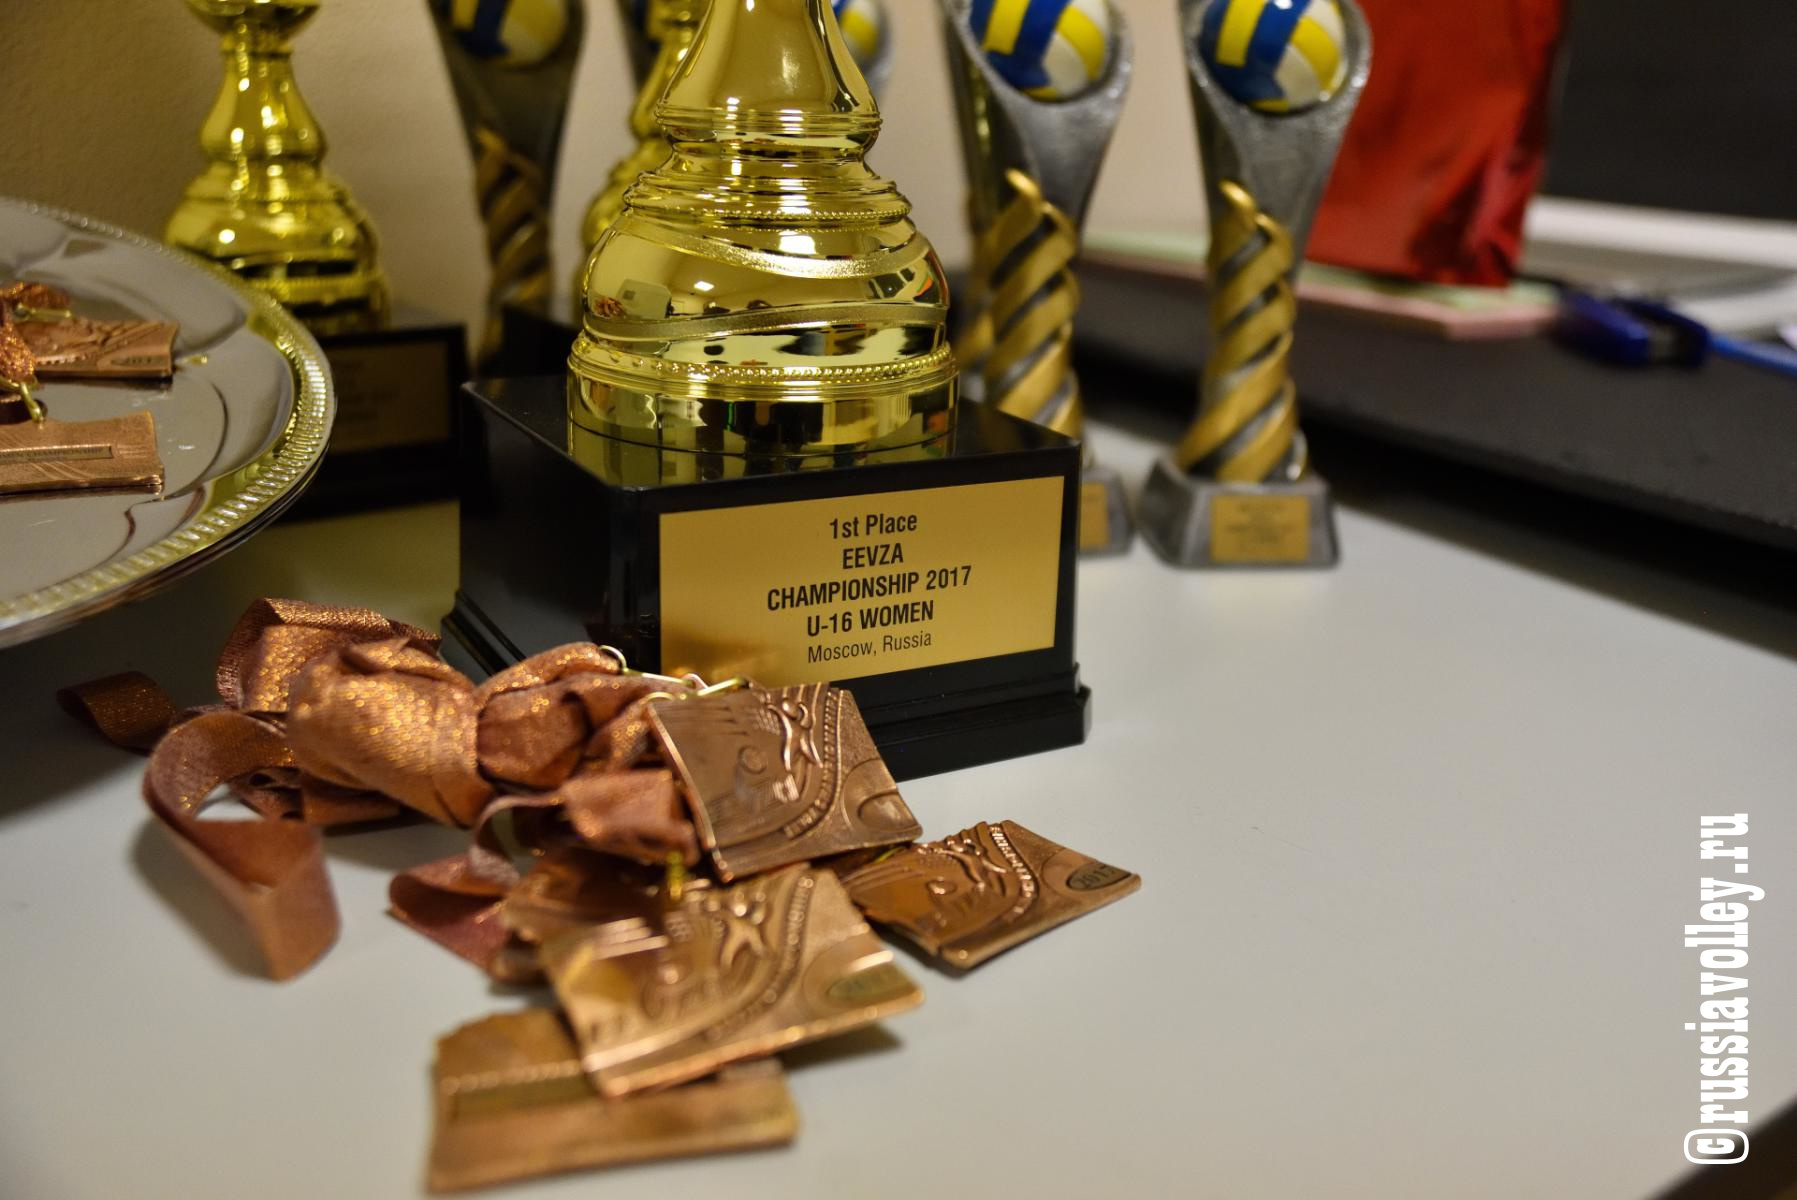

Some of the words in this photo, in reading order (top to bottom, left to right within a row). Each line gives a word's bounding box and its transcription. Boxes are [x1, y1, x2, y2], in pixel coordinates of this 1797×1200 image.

[829, 517, 859, 539] 1st
[865, 513, 917, 536] Place
[842, 543, 904, 570] EEVZA
[767, 572, 920, 611] CHAMPIONSHIP
[926, 565, 972, 590] 2017
[807, 612, 853, 637] U-16
[859, 600, 934, 630] WOMEN
[807, 642, 877, 663] Moscow,
[883, 631, 932, 653] Russia
